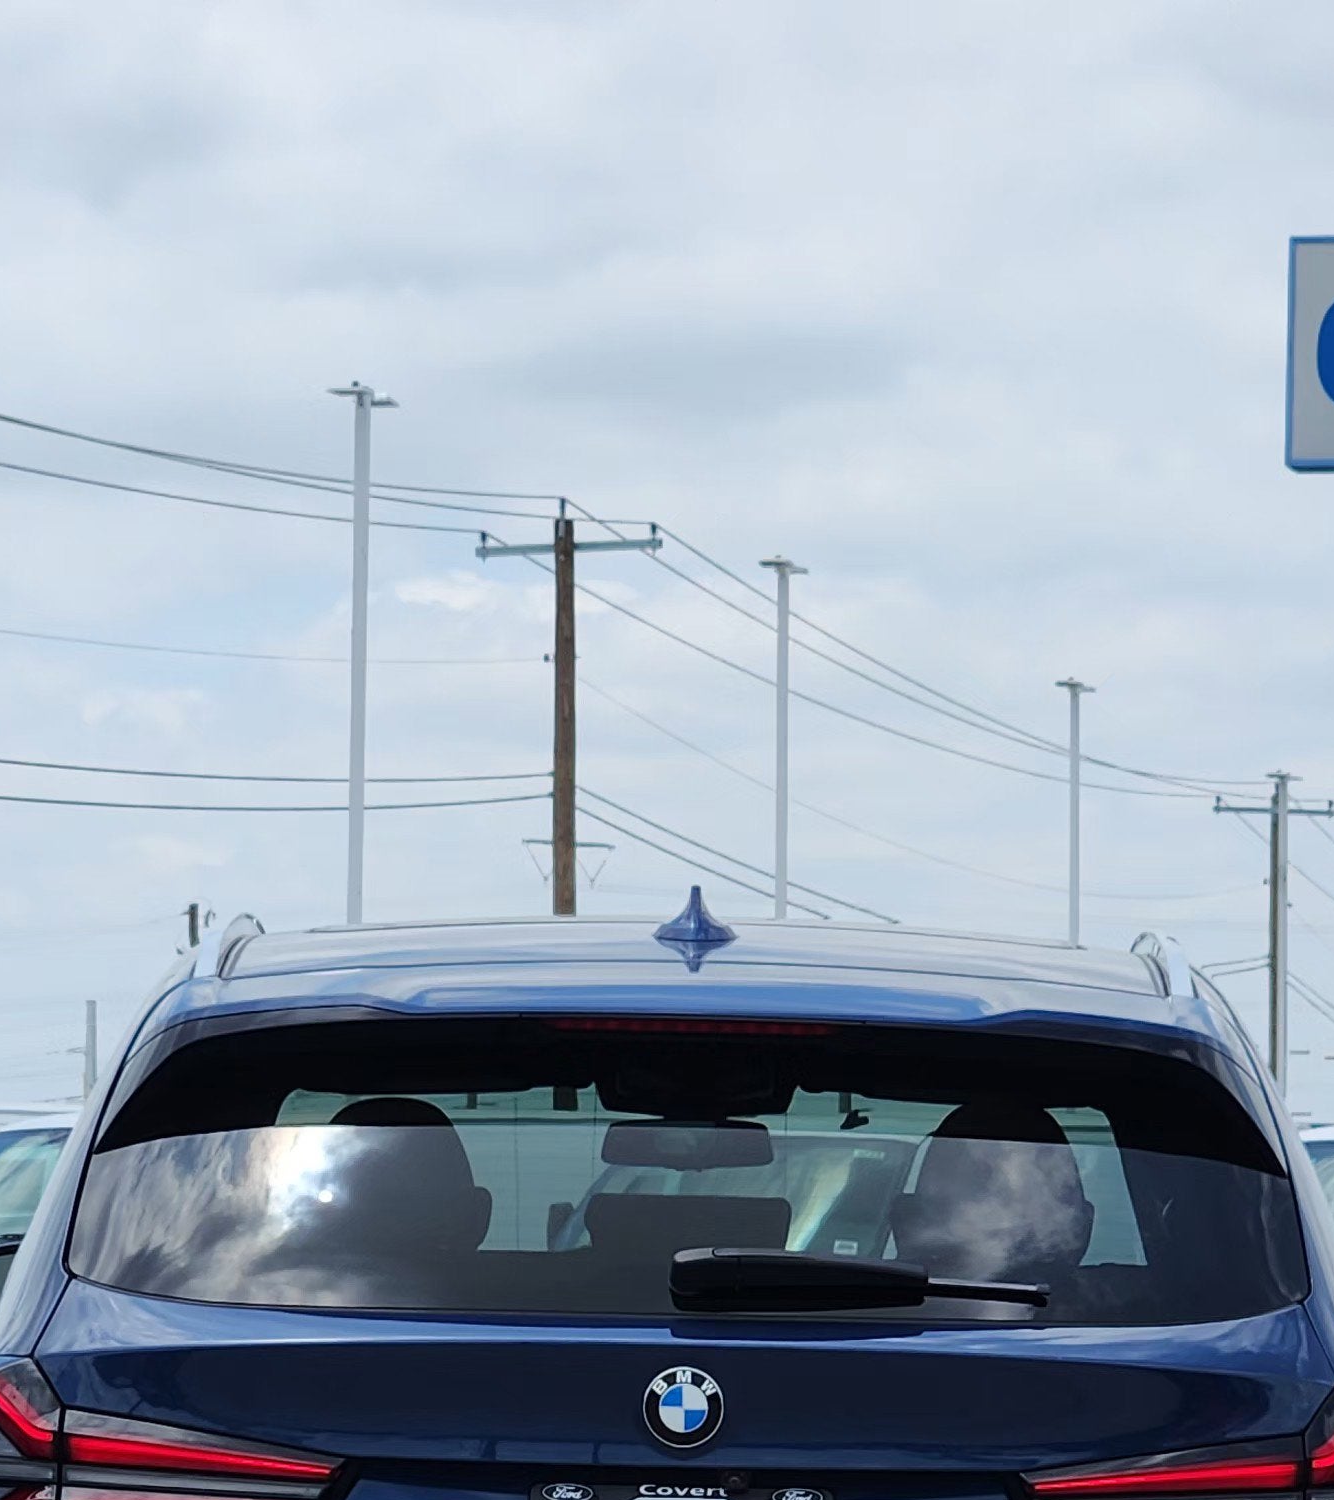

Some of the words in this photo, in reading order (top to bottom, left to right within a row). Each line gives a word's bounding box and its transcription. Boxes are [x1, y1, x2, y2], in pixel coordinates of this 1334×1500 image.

[652, 1370, 717, 1396] BMW
[552, 1486, 583, 1499] Ford
[639, 1484, 727, 1497] Covert
